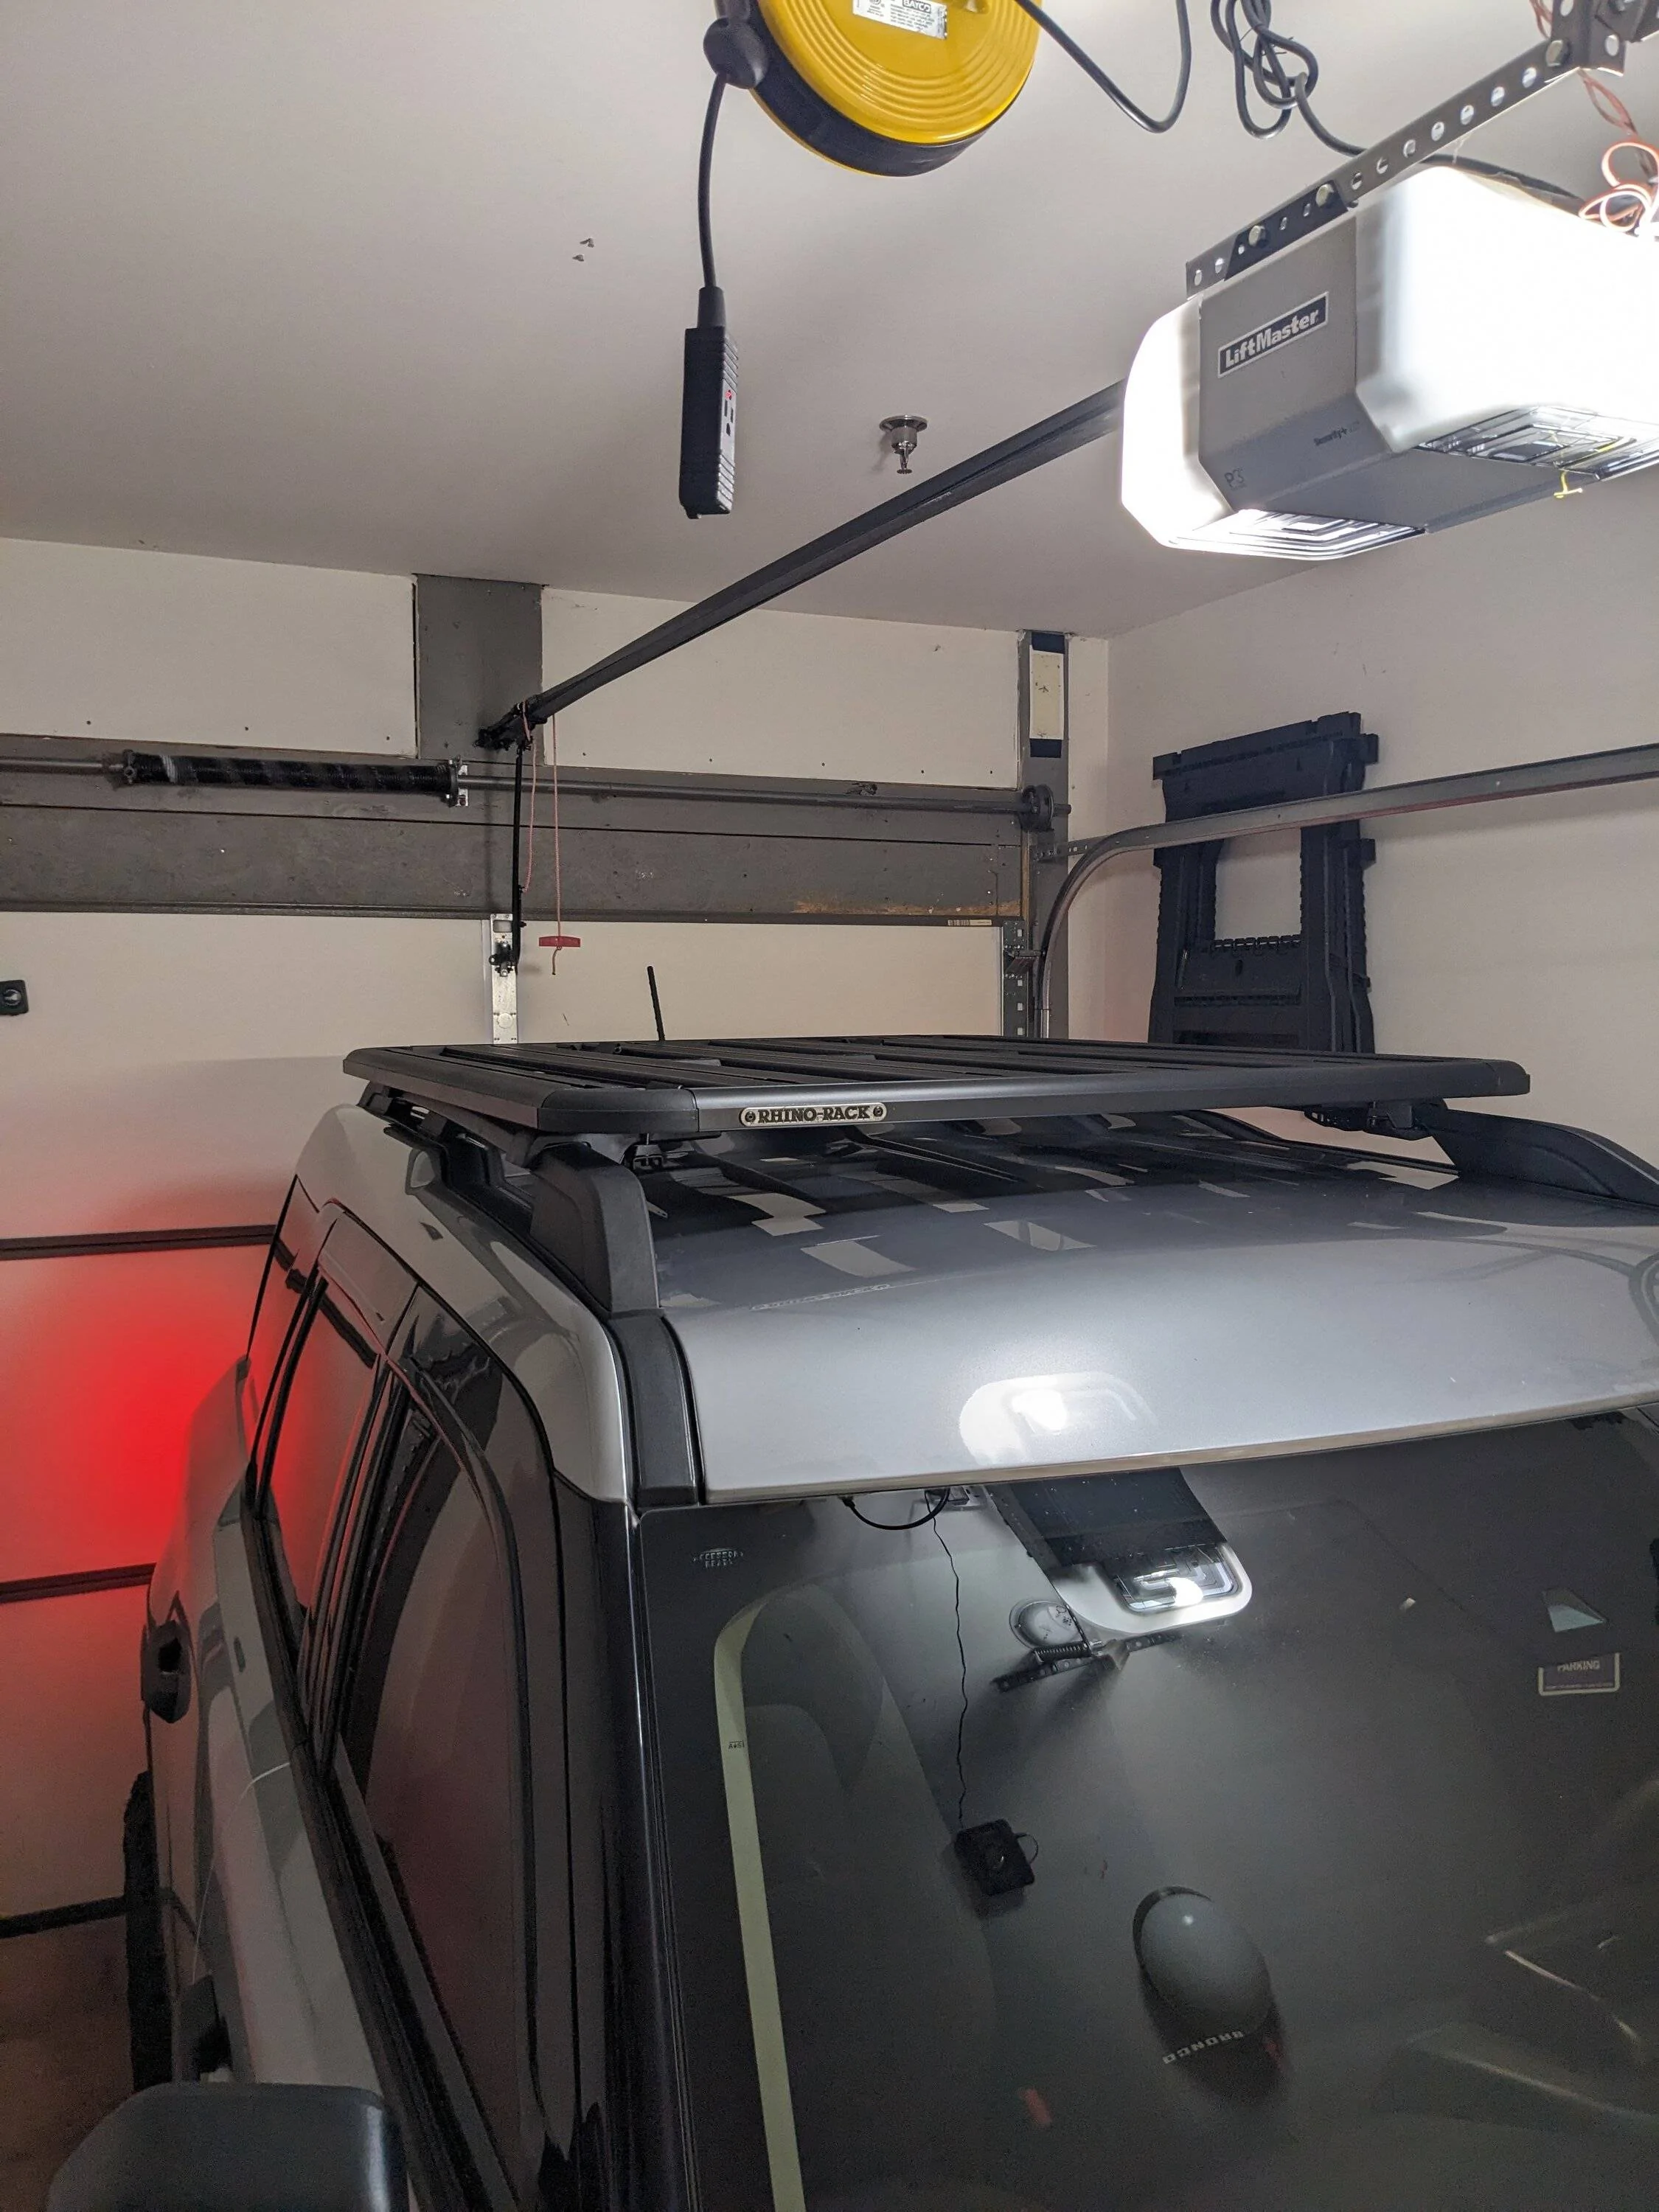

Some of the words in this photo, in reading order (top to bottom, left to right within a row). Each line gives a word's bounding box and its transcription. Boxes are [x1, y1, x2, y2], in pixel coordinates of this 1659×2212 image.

[903, 0, 931, 12] BAYCO
[1225, 310, 1319, 368] LiftMaster
[758, 1105, 871, 1124] RHINO-RACK
[1557, 1659, 1601, 1672] PARKING
[1162, 2031, 1244, 2064] BRONCO
